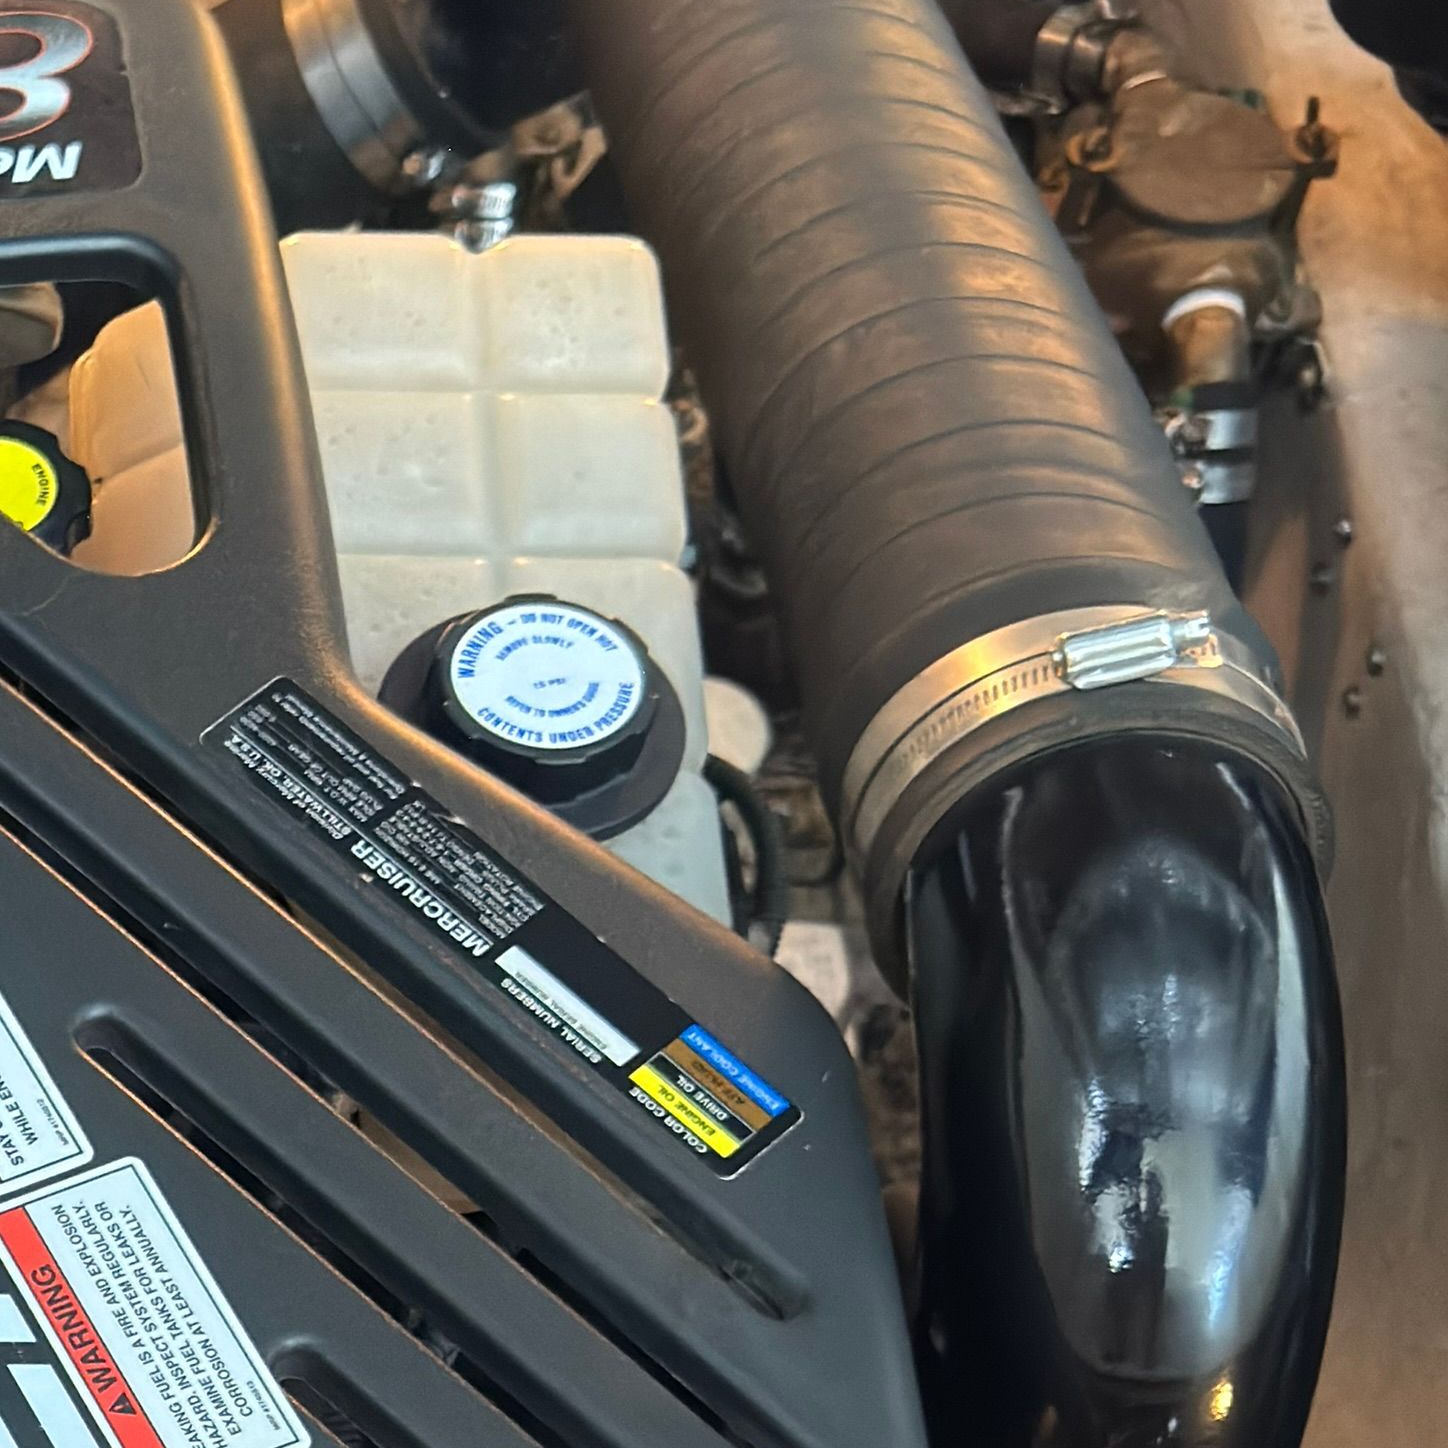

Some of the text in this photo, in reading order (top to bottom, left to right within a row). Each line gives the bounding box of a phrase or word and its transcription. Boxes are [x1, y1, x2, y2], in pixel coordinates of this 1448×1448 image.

[457, 621, 503, 679] WARNING
[519, 613, 537, 624] DO
[540, 613, 565, 625] NOT
[566, 618, 599, 639] OPEN
[477, 682, 634, 743] CONTENTS UNDER PRESSURE
[347, 838, 491, 957] MERCRUISER
[498, 976, 603, 1064] SERIAL NUMBERS
[673, 1074, 729, 1120] DRIVE OIL
[686, 1031, 780, 1110] ENGINE COOLANT
[3, 1101, 39, 1145] WHILE
[626, 1085, 710, 1154] COLOR CODE
[654, 1084, 716, 1136] ENGINE OIL
[50, 1203, 103, 1277] EXPLOSION
[70, 1199, 127, 1279] REGULARLY.
[92, 1201, 243, 1436] EXAMINE FUEL TANKS FOR LEAKS OR
[93, 1276, 121, 1306] AND
[116, 1204, 255, 1417] CORROSION AT LEAST ANNUALLY.
[117, 1279, 159, 1333] SYSTEM
[27, 1262, 120, 1393] WARNING
[111, 1306, 140, 1338] FIRE
[129, 1337, 147, 1350] A
[136, 1349, 156, 1365] IS
[145, 1364, 177, 1401] FUEL
[149, 1333, 193, 1390] INSPECT
